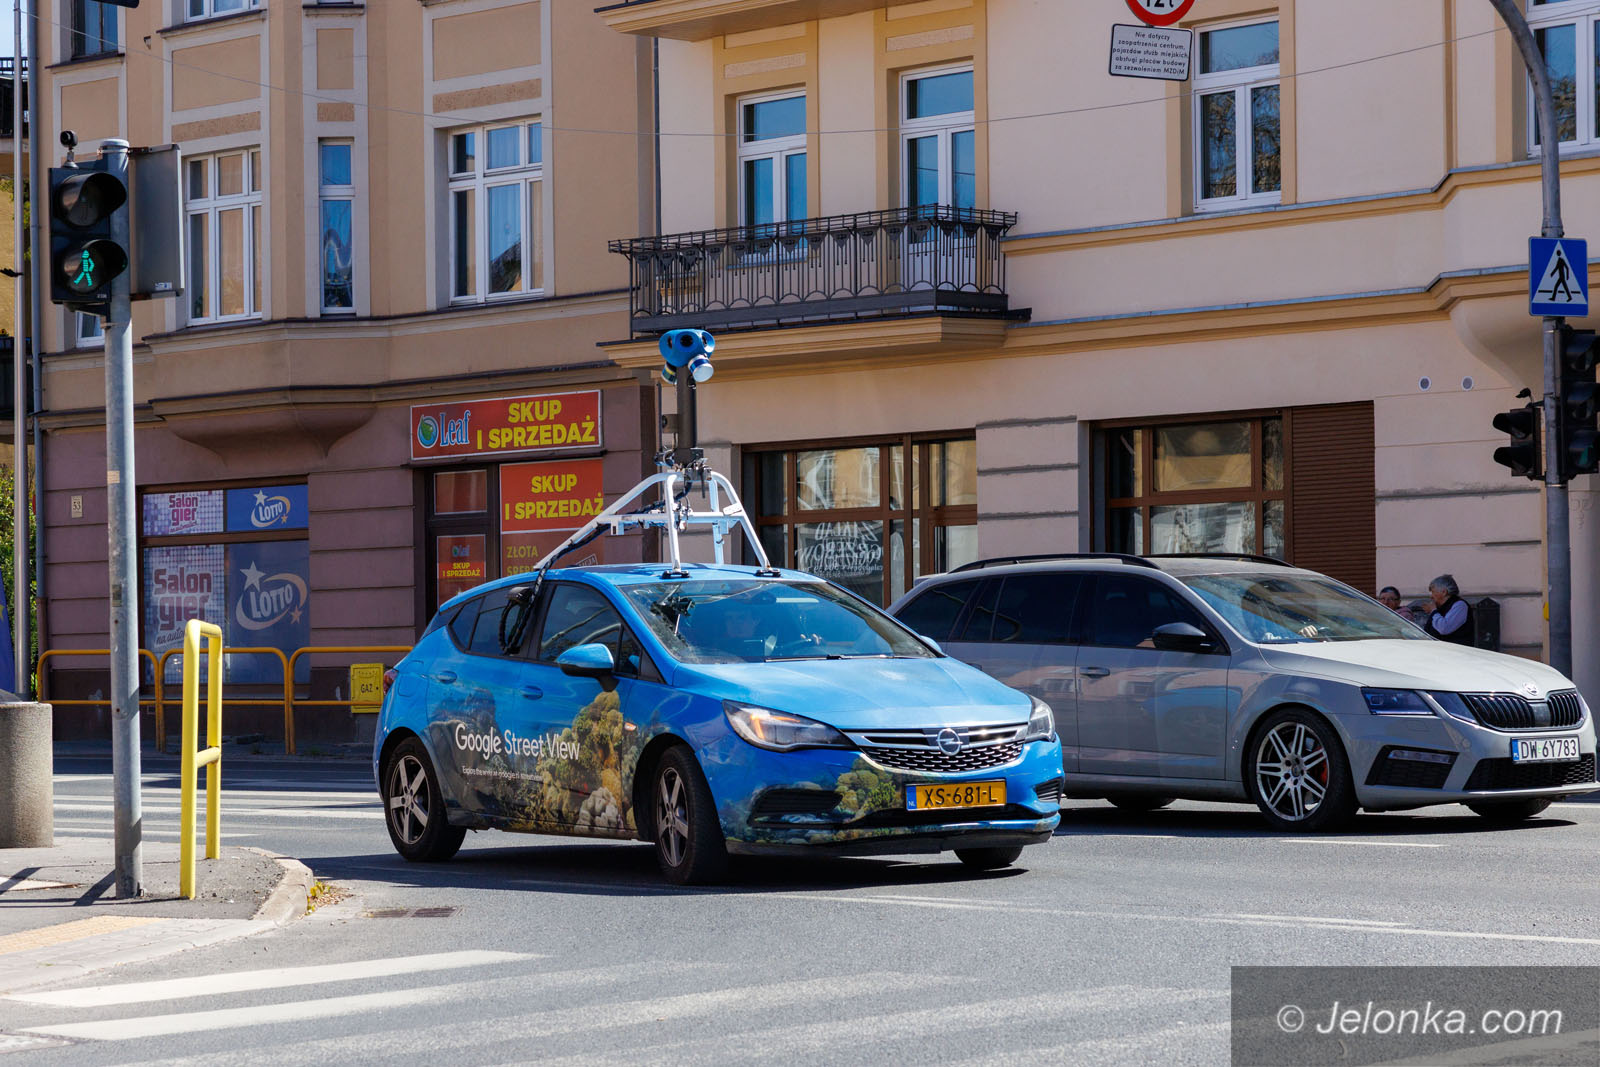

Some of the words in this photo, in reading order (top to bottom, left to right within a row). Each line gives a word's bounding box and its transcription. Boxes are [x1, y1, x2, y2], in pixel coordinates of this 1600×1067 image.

[1118, 39, 1158, 48] zaopatrzenia
[1148, 33, 1170, 41] dotyczy
[1112, 47, 1142, 55] pojazdów
[1115, 55, 1138, 63] obsługi
[1162, 59, 1186, 67] budowy
[1124, 65, 1161, 73] zezwoleniem
[508, 399, 562, 424] SKUP
[439, 409, 471, 447] Leaf
[476, 429, 483, 450] I
[488, 415, 596, 449] SPRZEDAŻ
[531, 473, 578, 494] SKUP
[168, 494, 199, 509] Salon
[504, 503, 510, 521] I
[514, 492, 604, 520] SPRZEDAŻ
[171, 507, 198, 527] gier
[258, 502, 283, 522] LOTTO
[506, 545, 539, 559] ZŁOTA
[446, 568, 481, 577] SPRZEDAŻ
[452, 562, 471, 570] SKUP
[154, 567, 212, 595] Salon
[250, 584, 293, 619] LOTTO
[159, 594, 210, 631] gier
[360, 683, 373, 694] GAZ
[455, 723, 502, 761] Google
[504, 729, 545, 758] Street
[546, 732, 580, 761] View
[1520, 740, 1538, 759] DW
[1542, 739, 1577, 758] 6Y783
[924, 785, 998, 807] XS-681-L
